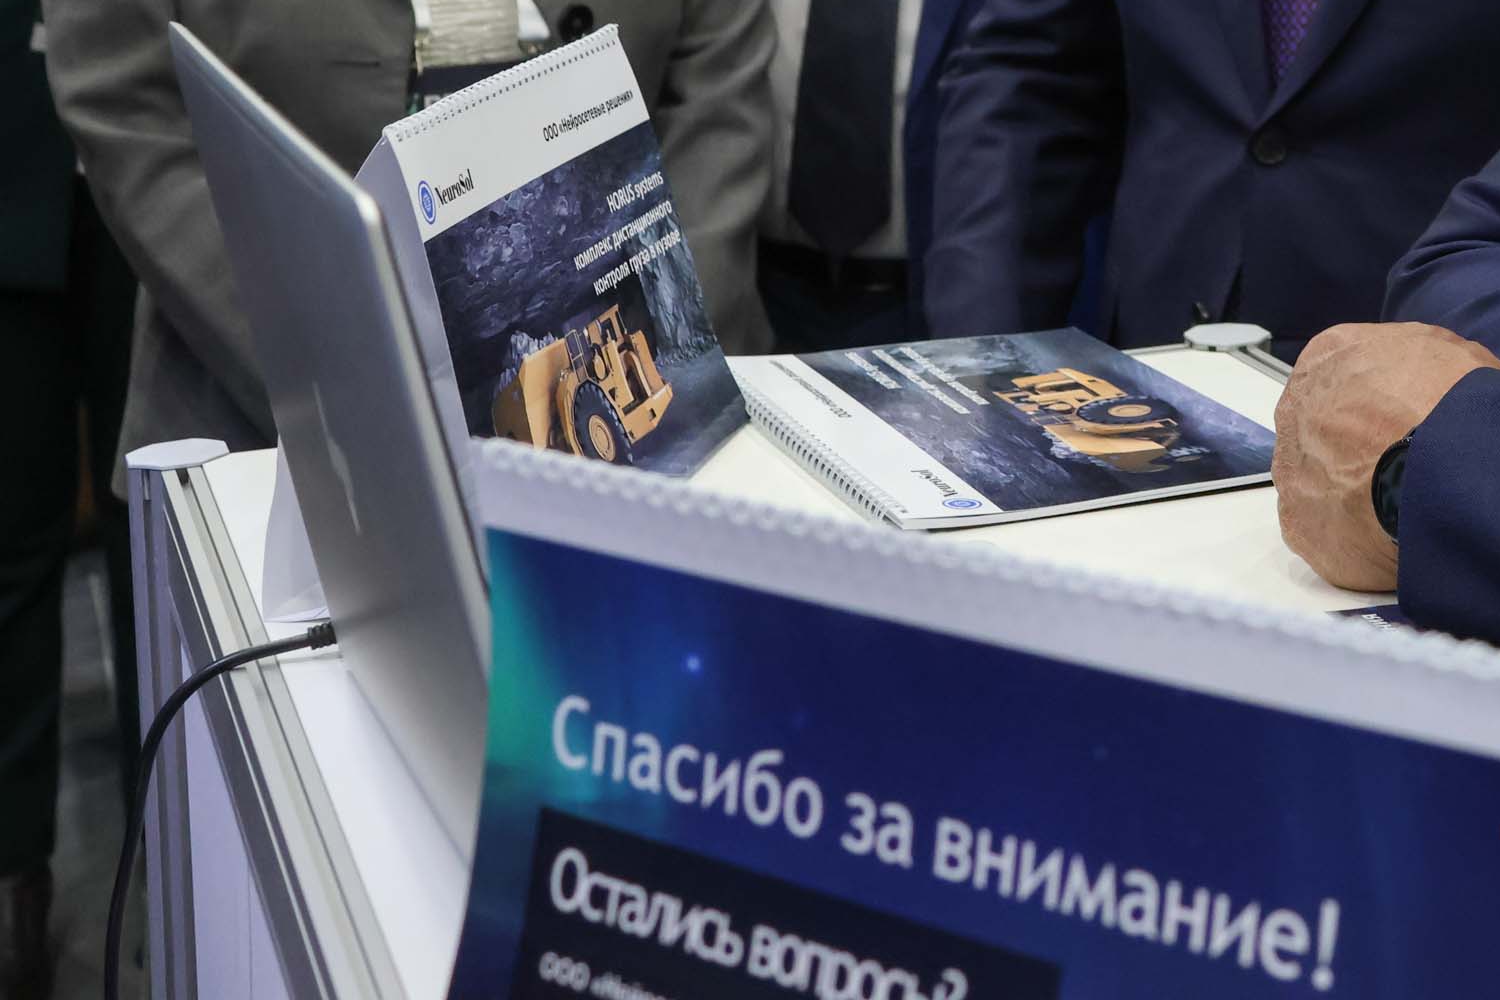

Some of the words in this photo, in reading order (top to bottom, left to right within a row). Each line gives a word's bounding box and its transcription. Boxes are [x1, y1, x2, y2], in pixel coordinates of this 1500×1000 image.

[606, 183, 636, 214] HORUS
[634, 171, 664, 200] systems
[573, 236, 614, 271] комплекс
[611, 199, 673, 252] дистанционного
[593, 261, 631, 296] контроля
[628, 247, 651, 274] груза
[648, 244, 657, 259] в
[654, 228, 681, 256] кузове
[552, 695, 824, 839] Спасибо
[839, 792, 914, 869] за
[932, 816, 1341, 992] внимание!
[550, 846, 745, 968] Остались
